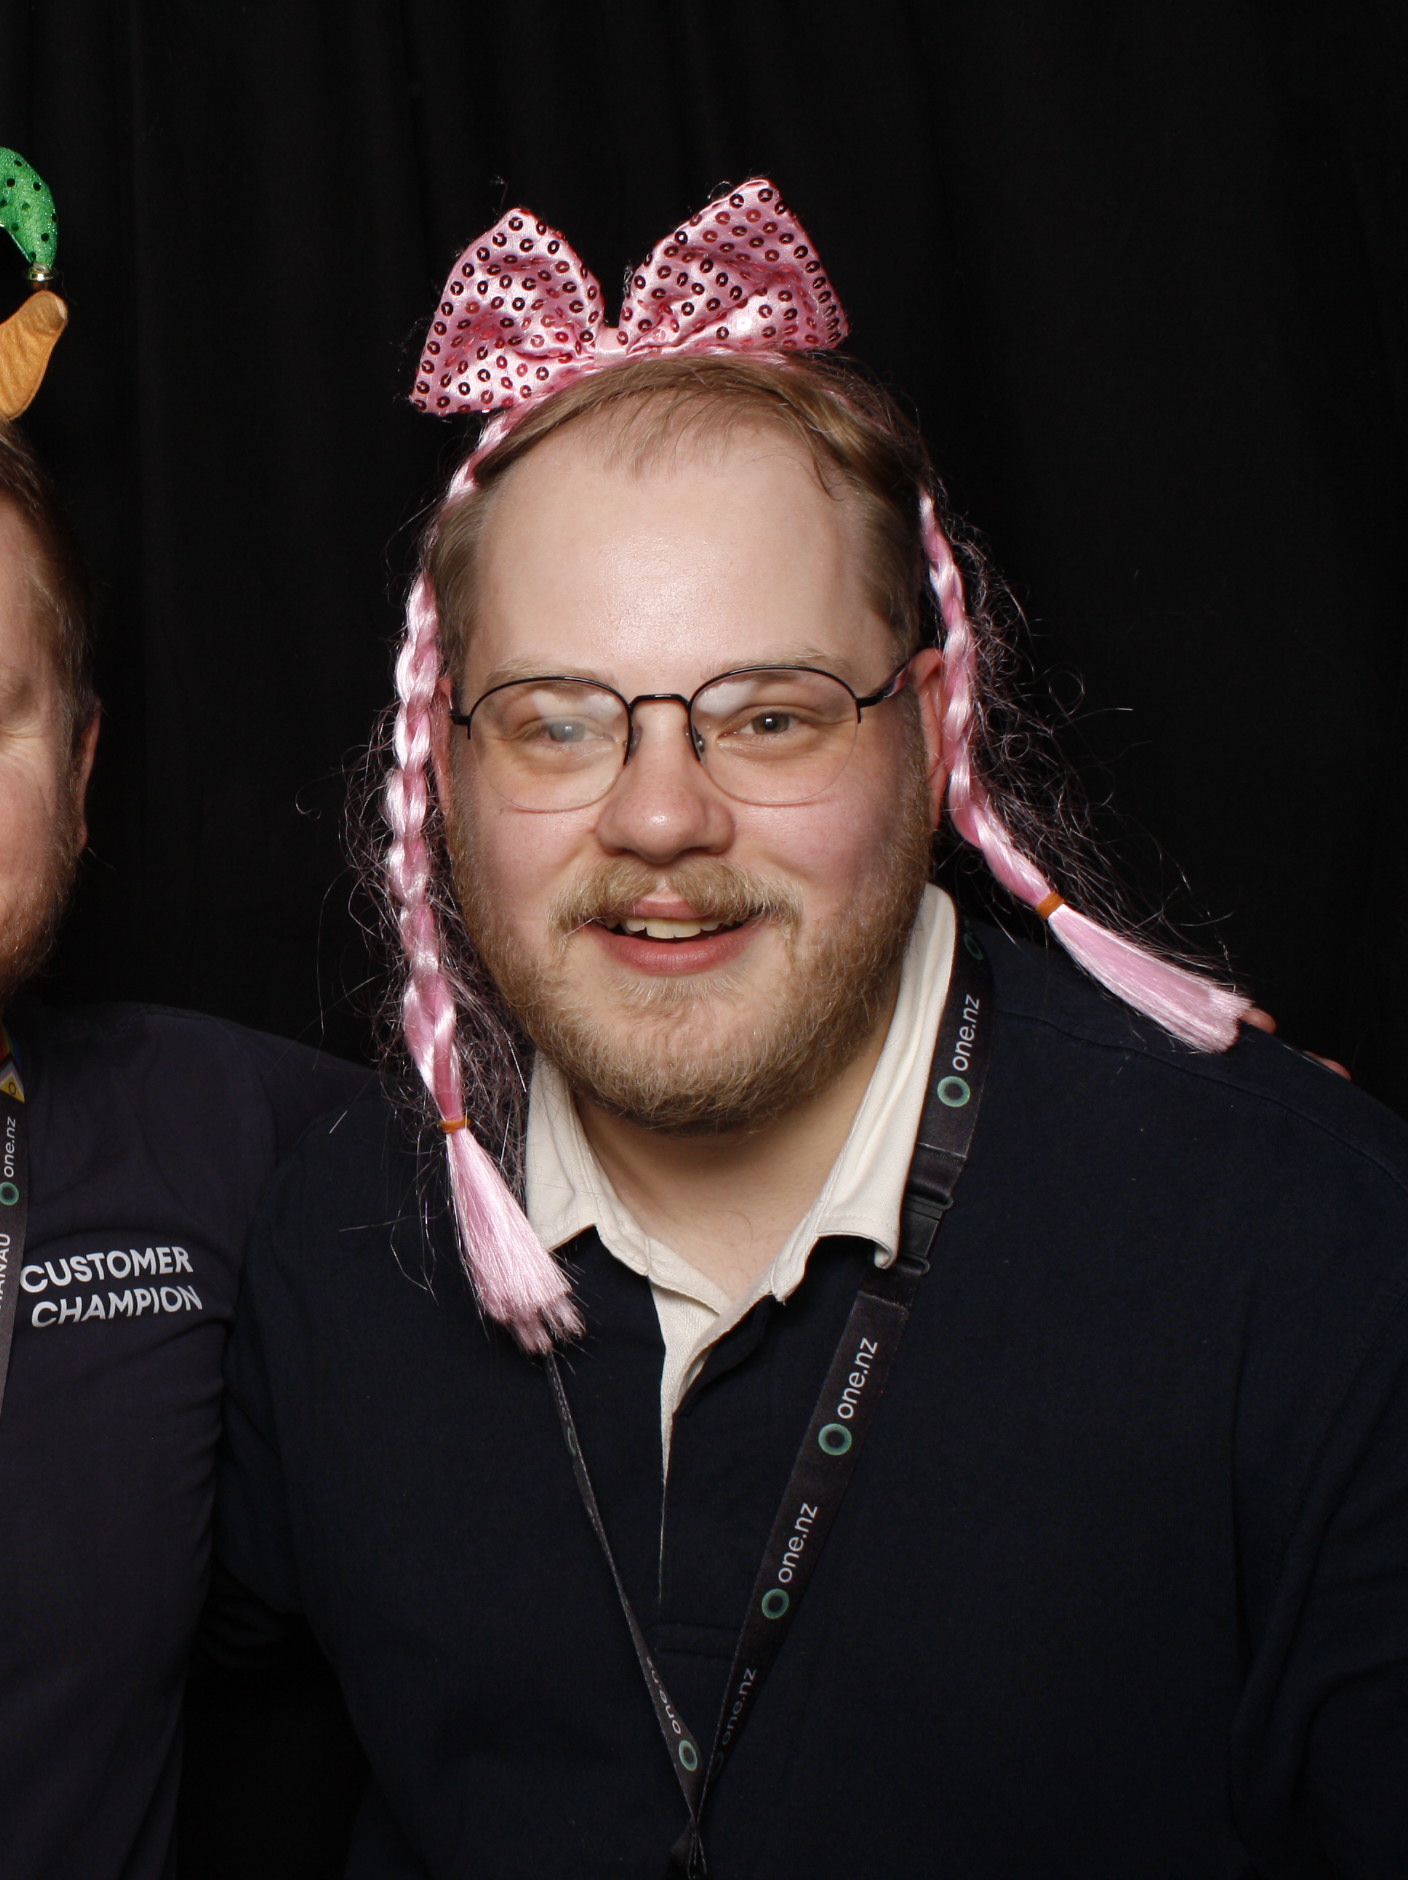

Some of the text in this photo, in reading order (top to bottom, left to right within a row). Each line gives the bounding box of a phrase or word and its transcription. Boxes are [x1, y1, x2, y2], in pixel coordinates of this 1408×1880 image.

[951, 994, 980, 1072] one.nz
[3, 1116, 16, 1178] one.nz
[19, 1246, 194, 1293] CUSTOMER
[31, 1285, 203, 1328] CHAMPION
[836, 1337, 878, 1420] one.nz
[778, 1502, 818, 1583] one.nz
[722, 1668, 757, 1745] one.nz
